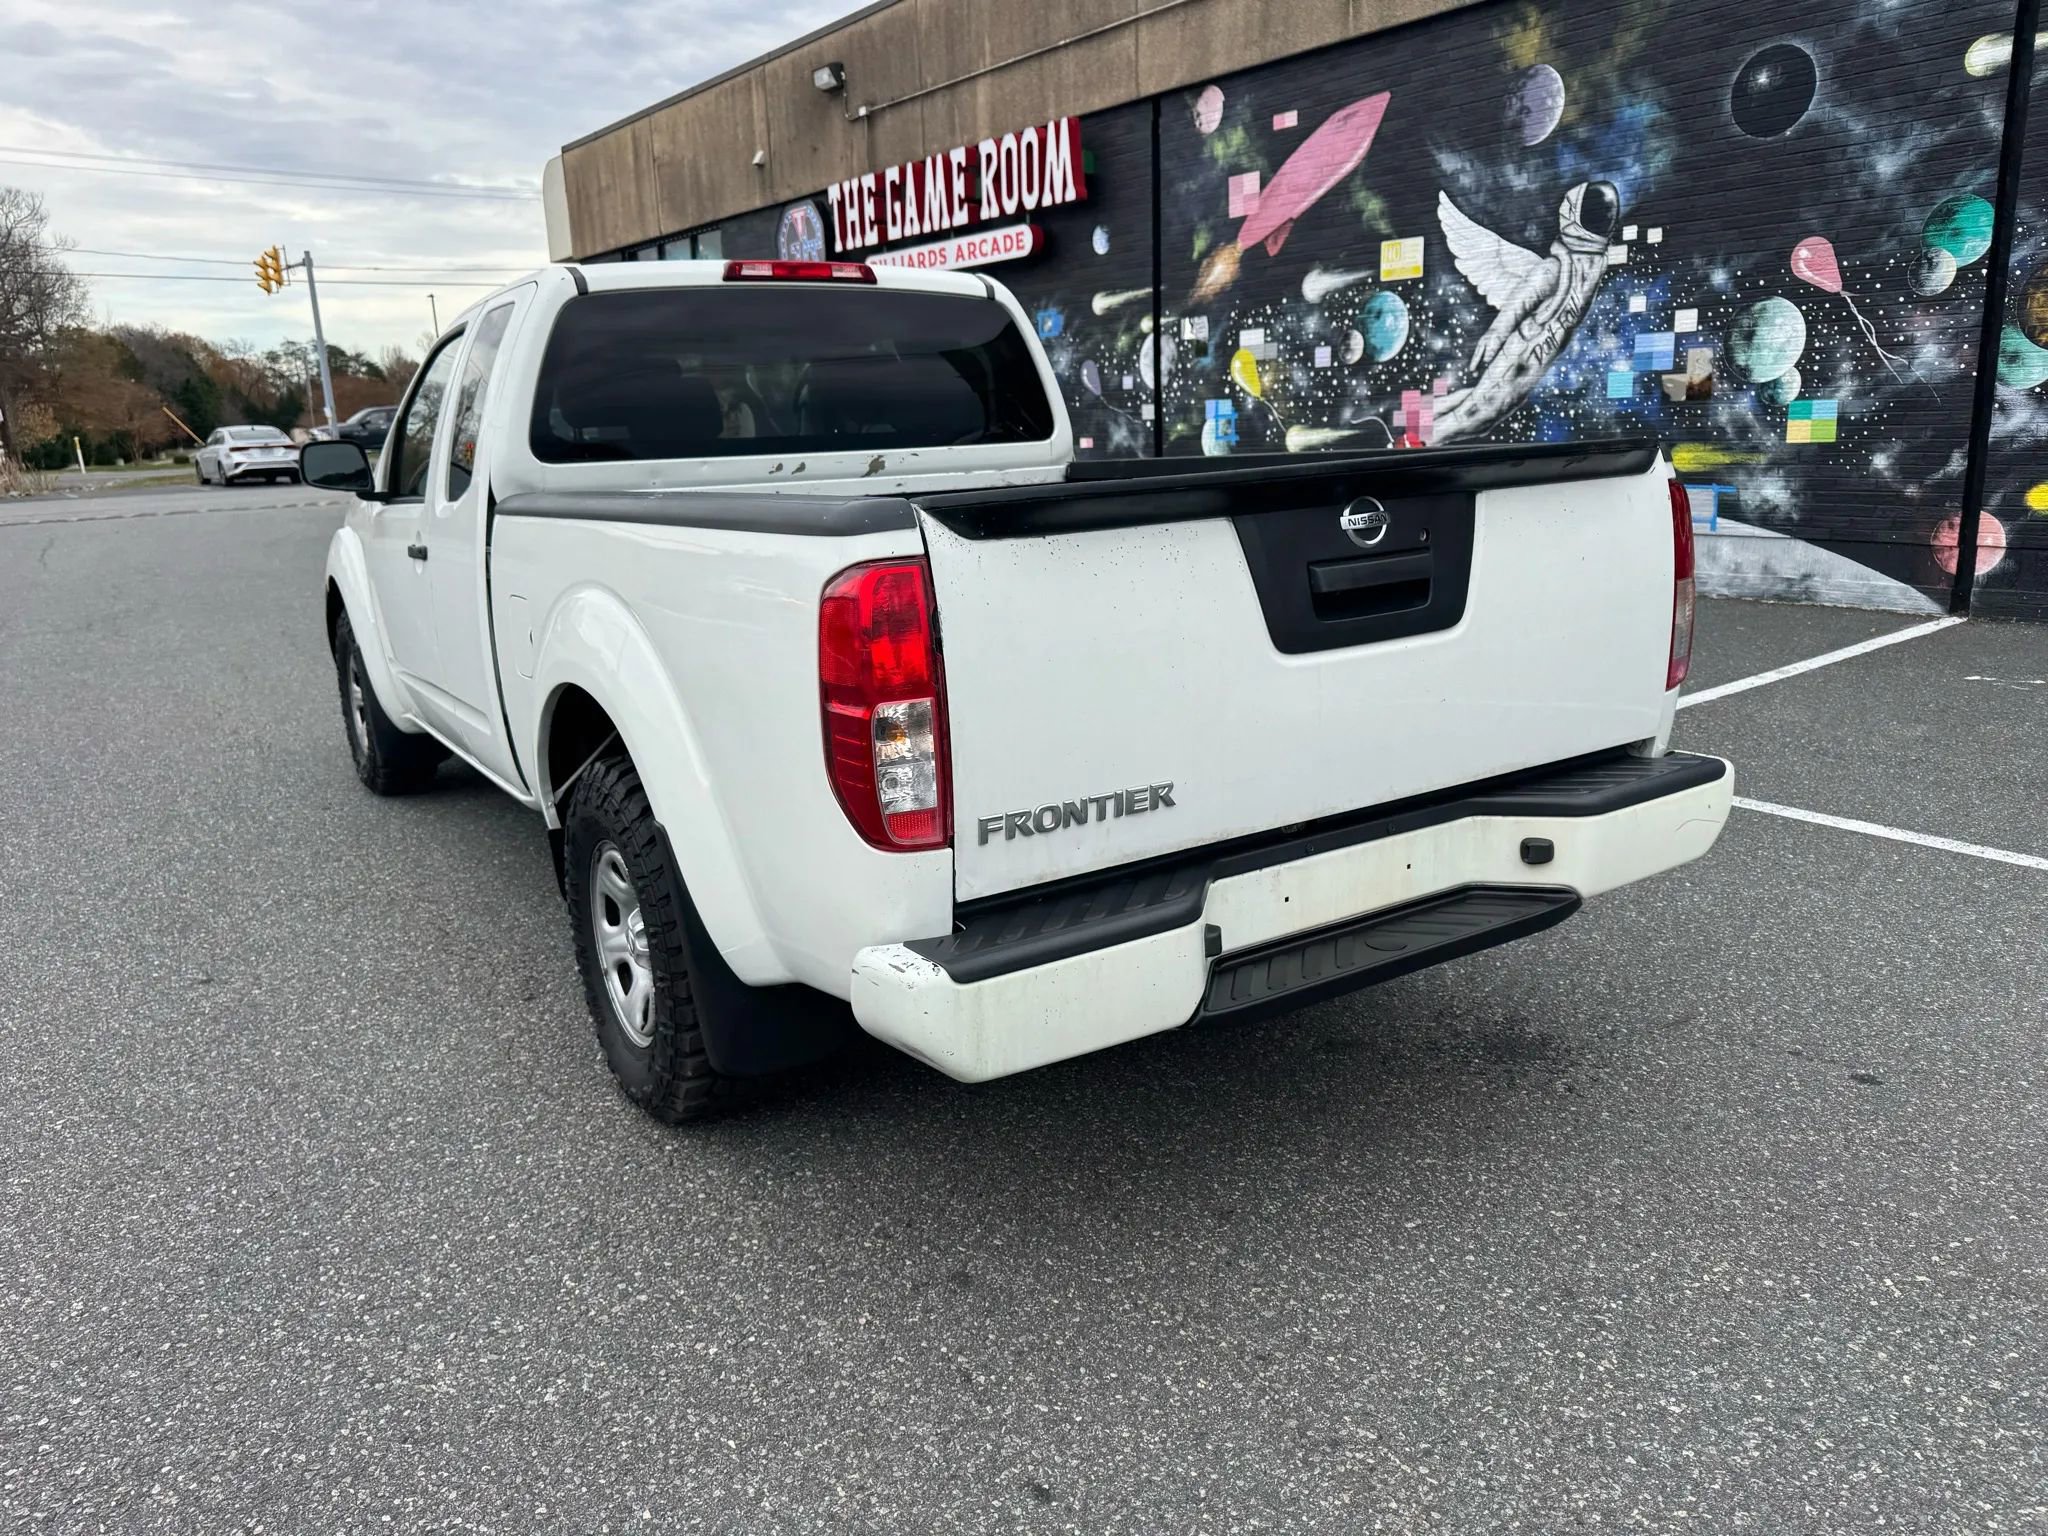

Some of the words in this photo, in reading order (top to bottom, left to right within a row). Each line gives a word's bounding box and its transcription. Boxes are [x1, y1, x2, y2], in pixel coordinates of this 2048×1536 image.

[828, 172, 879, 253] THE
[885, 146, 969, 241] GAME
[978, 116, 1077, 220] ROOM
[955, 231, 1025, 263] ARCADE
[1347, 513, 1388, 527] NISSAN
[977, 780, 1176, 846] FRONTIER
